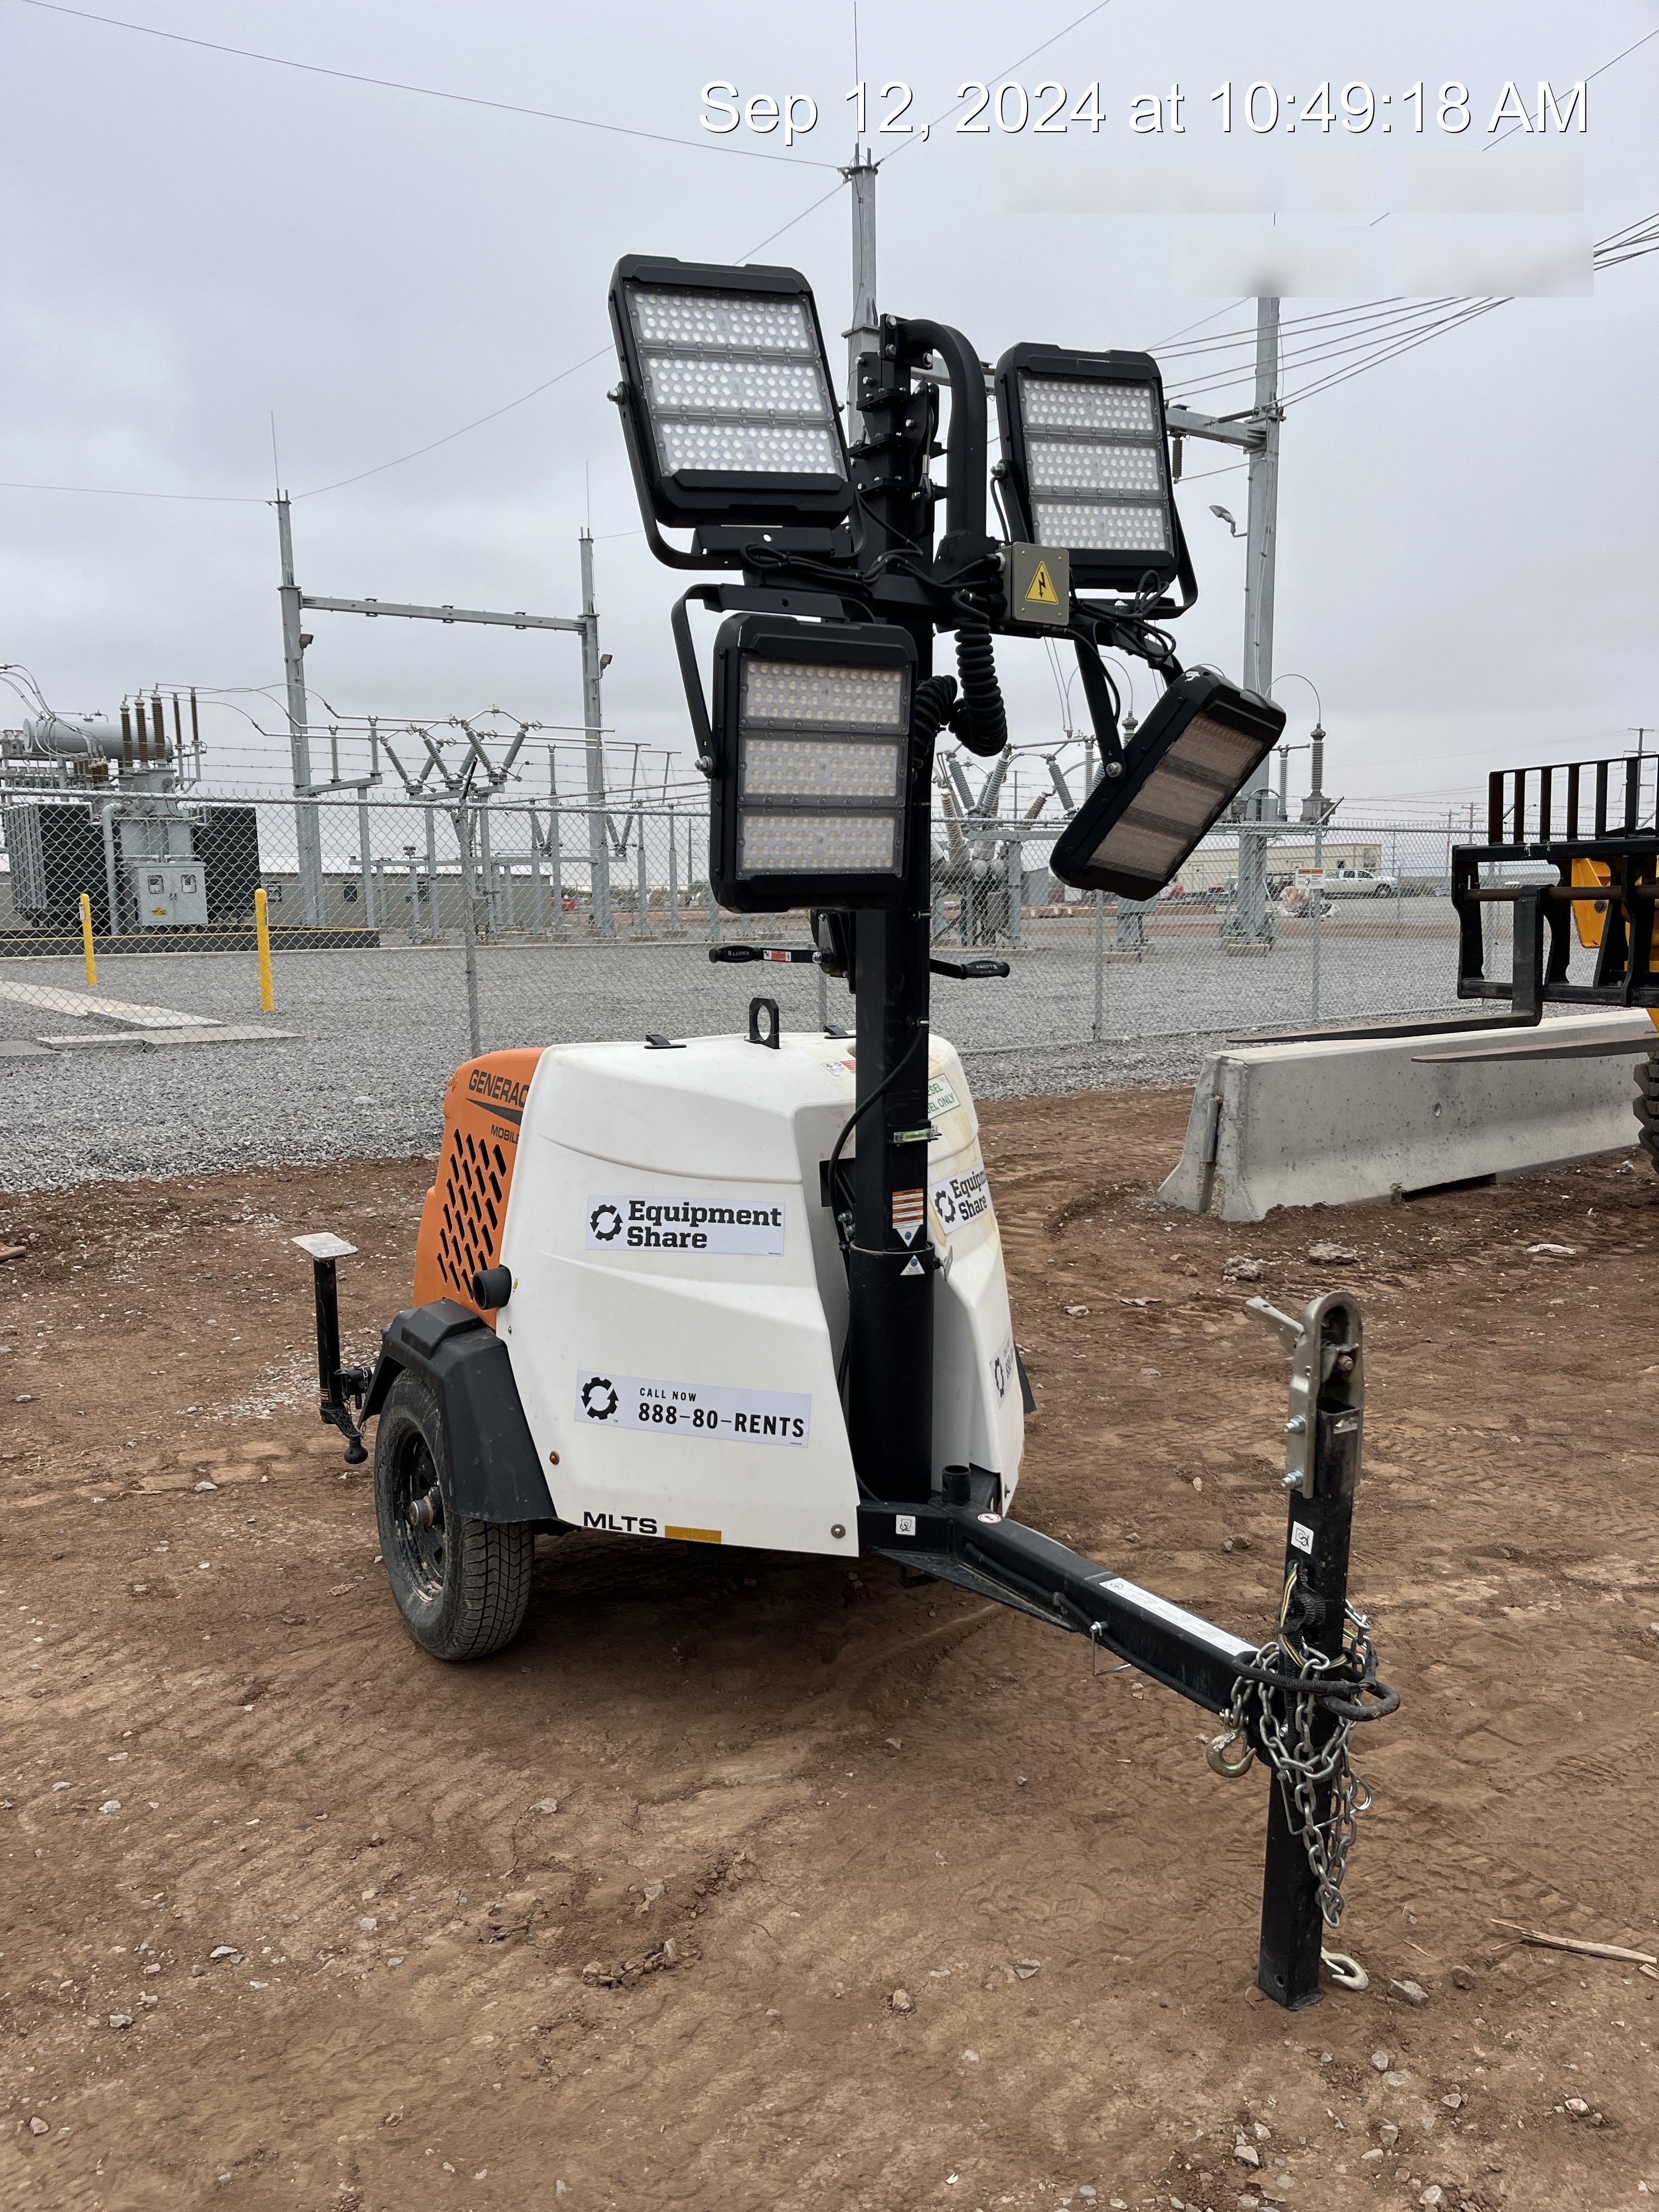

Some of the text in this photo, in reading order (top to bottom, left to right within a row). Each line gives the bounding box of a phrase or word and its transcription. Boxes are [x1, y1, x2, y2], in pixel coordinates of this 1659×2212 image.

[469, 1069, 530, 1108] GENERAC
[938, 1092, 955, 1107] ONLY
[628, 1200, 782, 1228] Equipment
[958, 1195, 988, 1221] Share
[627, 1226, 707, 1249] Share
[640, 1387, 697, 1402] CALL NOW
[638, 1402, 804, 1437] 888-80-RENTS
[583, 1511, 658, 1534] MLTS
